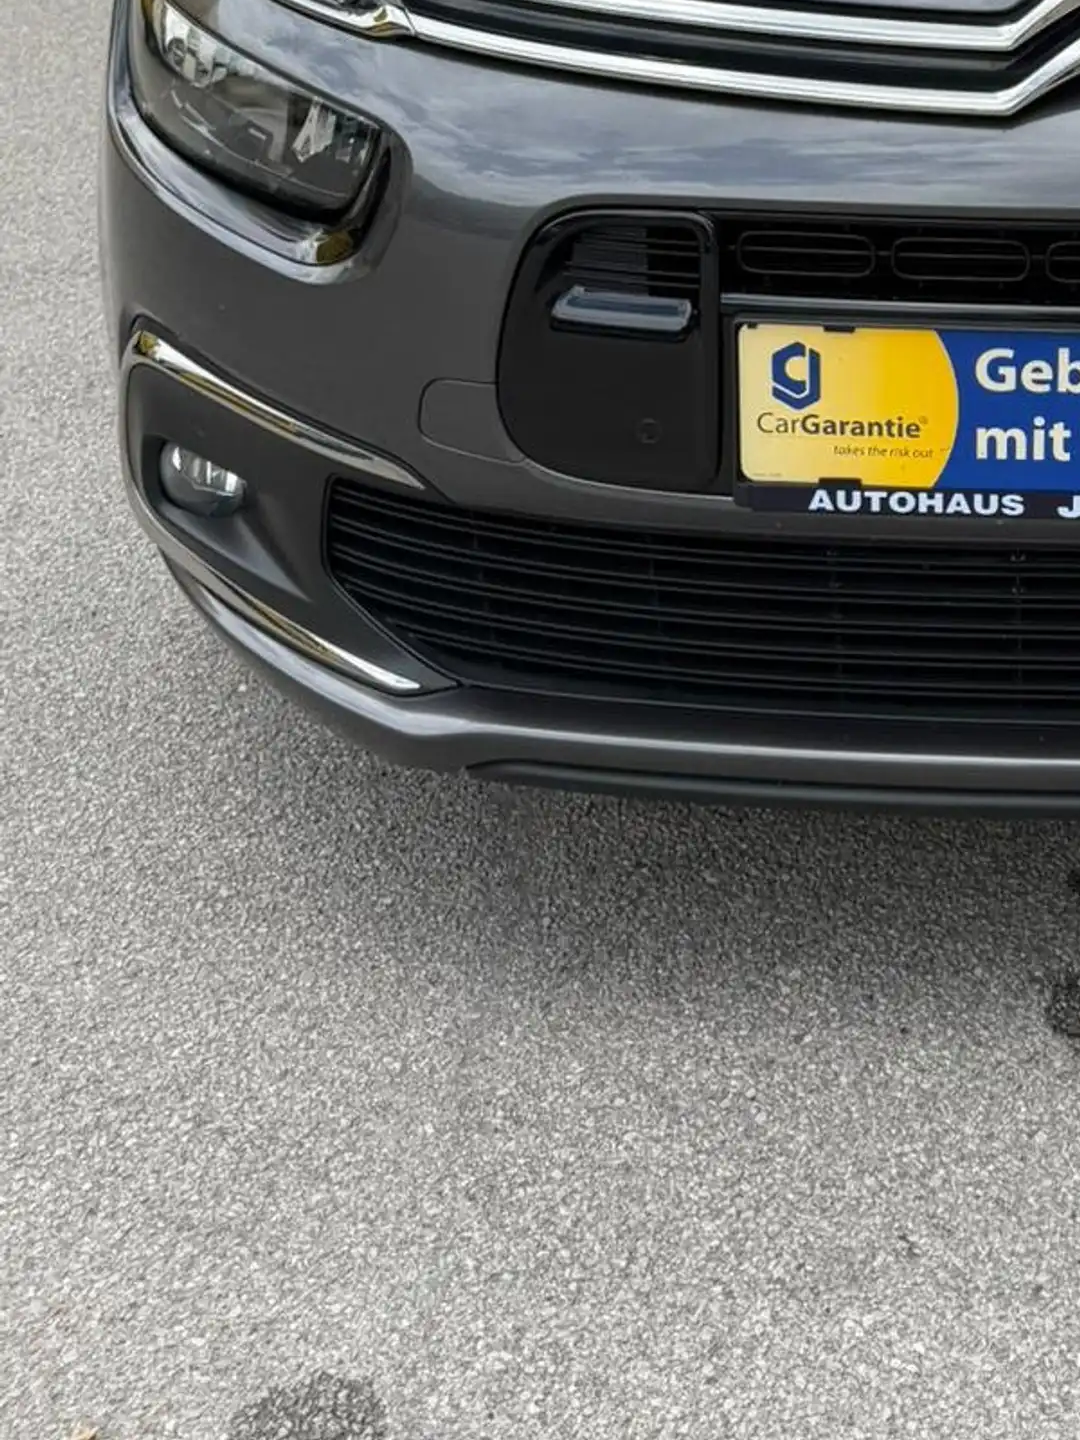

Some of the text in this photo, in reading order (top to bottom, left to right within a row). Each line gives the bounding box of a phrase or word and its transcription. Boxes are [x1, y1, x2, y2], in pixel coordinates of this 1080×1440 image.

[833, 444, 933, 459] takes the risk out
[974, 416, 1072, 461] mit
[808, 489, 1026, 516] AUTOHAUS
